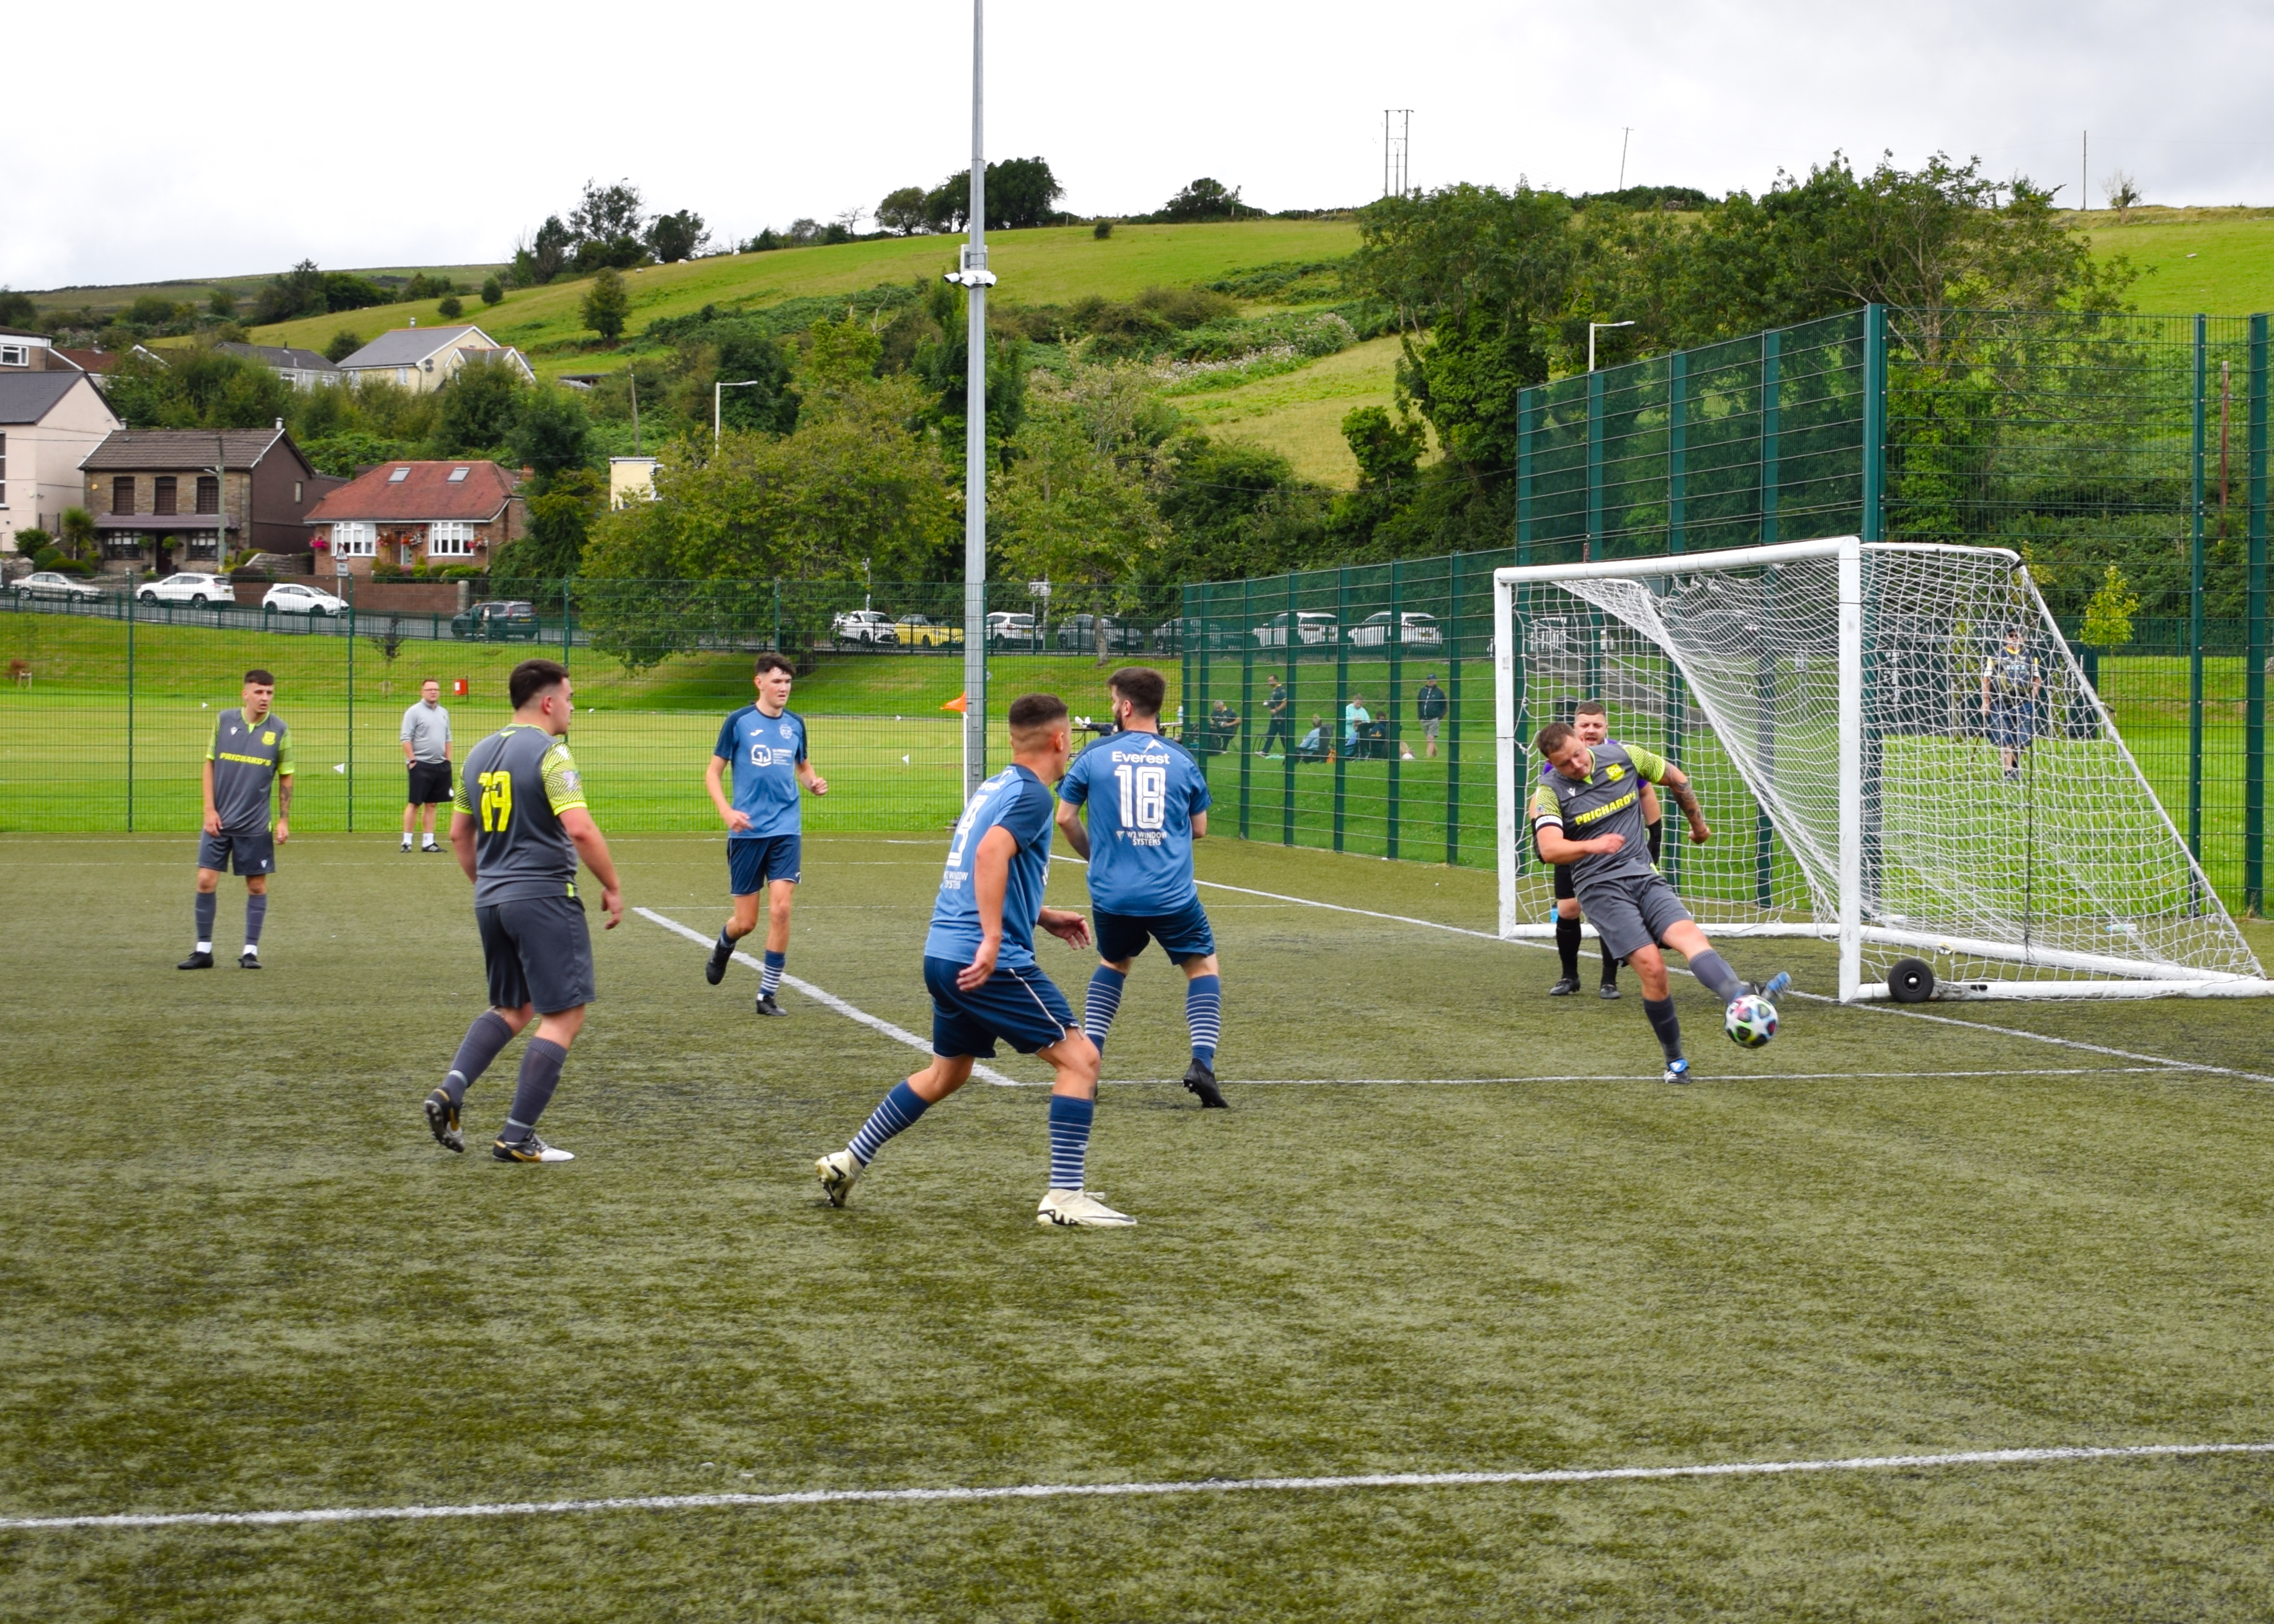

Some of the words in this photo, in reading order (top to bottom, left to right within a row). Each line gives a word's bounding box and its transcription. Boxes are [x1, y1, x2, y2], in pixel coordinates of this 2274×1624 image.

[220, 752, 272, 767] PRICHARD'S
[1112, 751, 1170, 764] Everest
[478, 770, 512, 832] 19
[1114, 765, 1166, 829] 18
[1575, 790, 1636, 826] PRICHARD'S
[1126, 831, 1137, 839] W2
[1137, 831, 1167, 839] WINDOW
[1133, 838, 1161, 846] SYSTEMS
